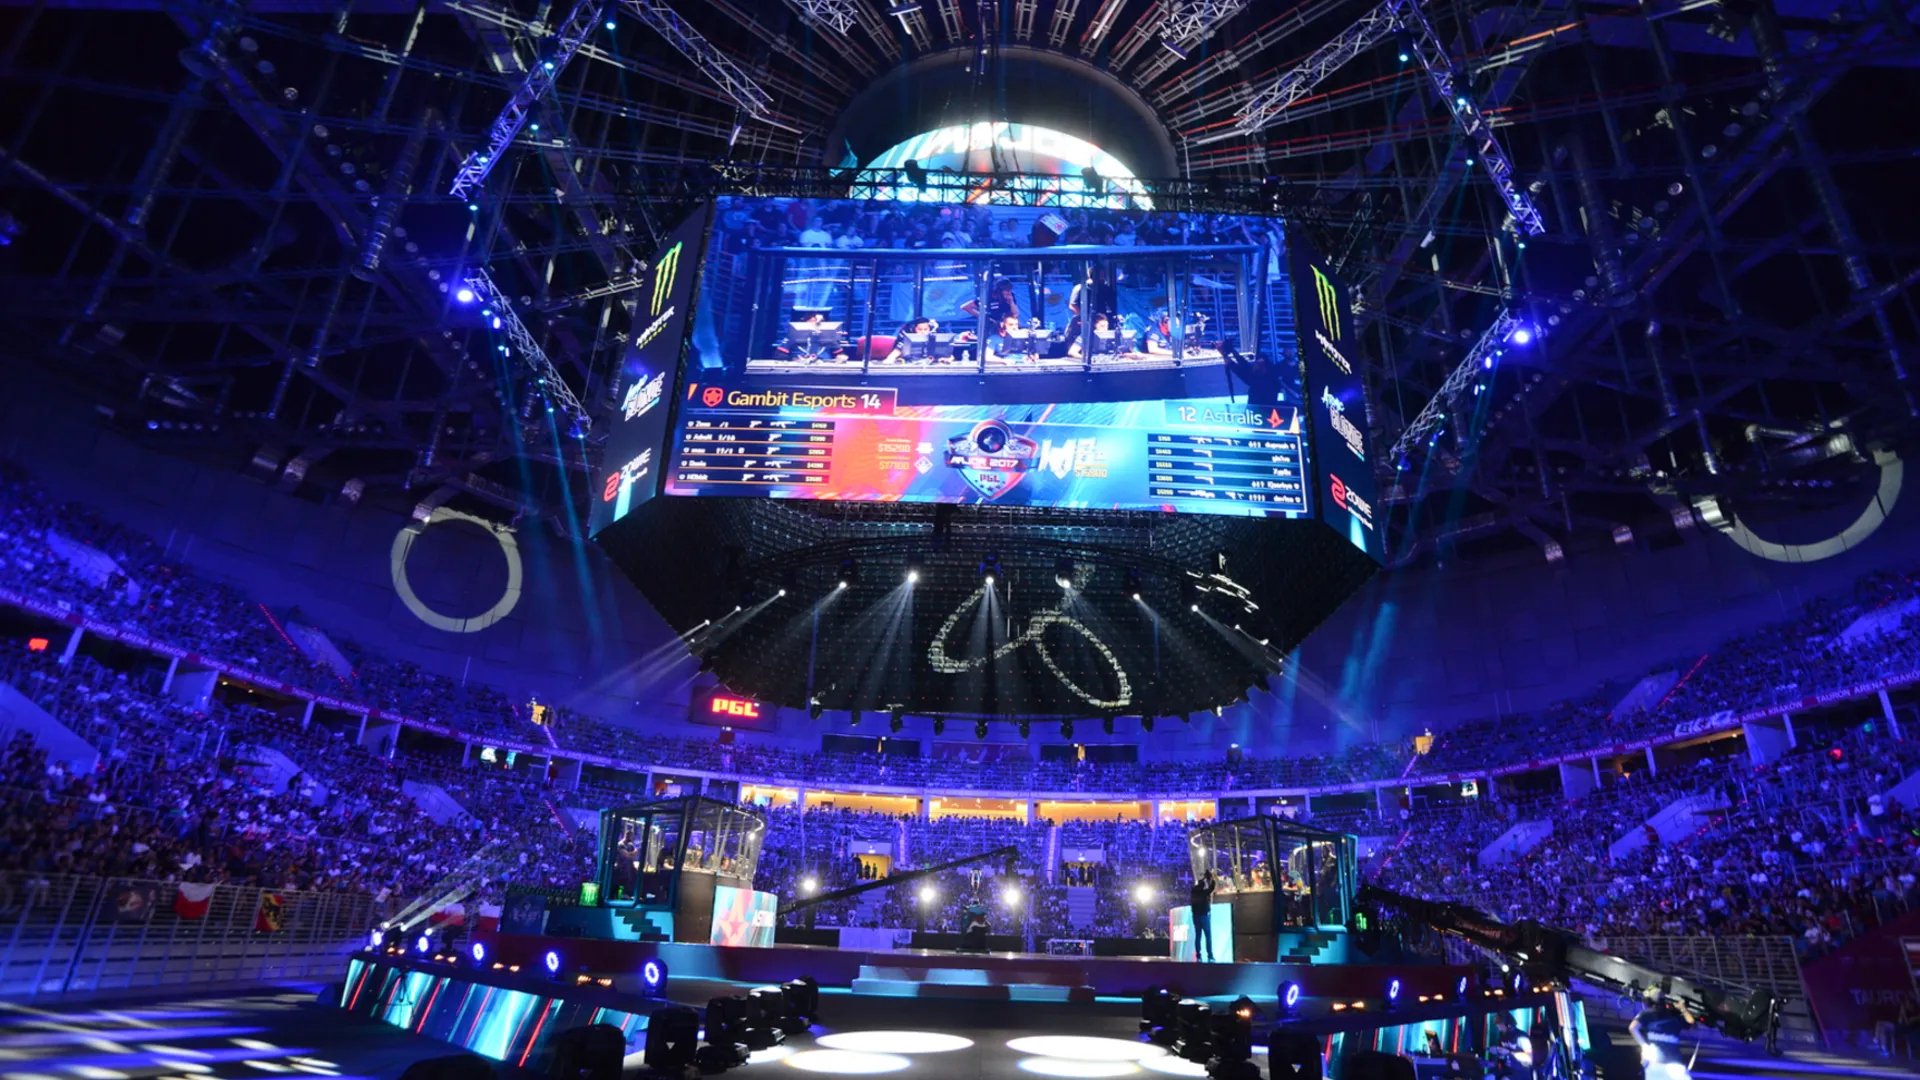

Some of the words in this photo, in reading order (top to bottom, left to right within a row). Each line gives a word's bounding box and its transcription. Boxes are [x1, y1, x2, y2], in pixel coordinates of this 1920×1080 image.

[727, 390, 788, 407] Gambit
[792, 391, 856, 409] Esports
[860, 393, 881, 409] 14
[1177, 406, 1197, 422] 12
[1202, 408, 1263, 426] Astralis
[712, 698, 759, 718] PGL
